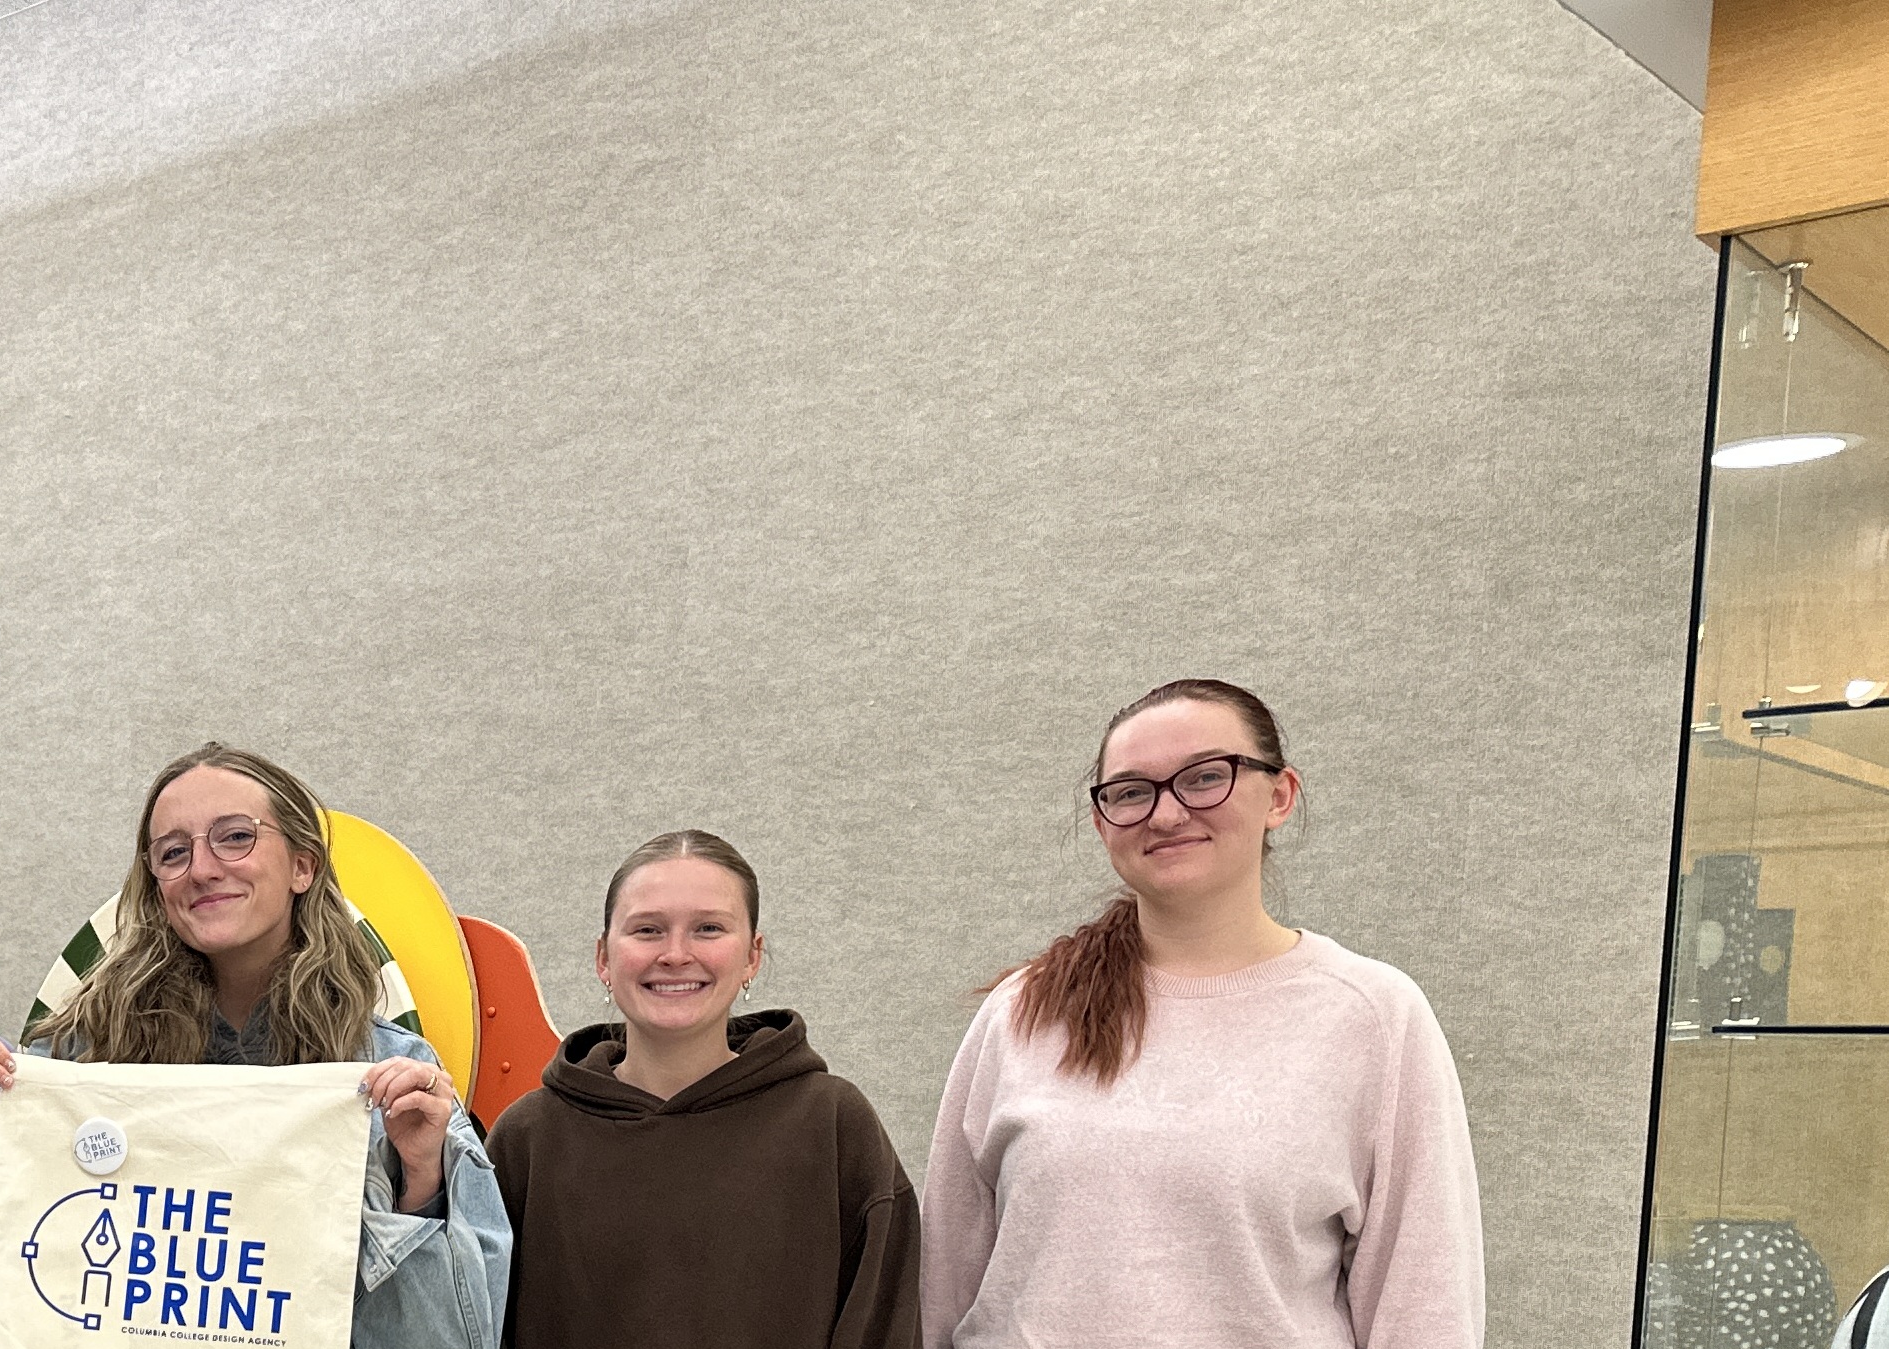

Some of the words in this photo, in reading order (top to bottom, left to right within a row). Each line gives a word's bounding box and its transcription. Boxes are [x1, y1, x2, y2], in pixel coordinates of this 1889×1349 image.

[88, 1131, 108, 1144] THE
[90, 1137, 117, 1152] BLUE
[93, 1144, 121, 1160] PRINT
[133, 1184, 233, 1235] THE
[128, 1231, 266, 1285] BLUE
[122, 1277, 292, 1334] PRINT
[120, 1326, 167, 1338] COLUMBIA
[169, 1330, 210, 1342] COLLEGE
[212, 1334, 245, 1344] DESIGN
[247, 1336, 287, 1347] AGENCY
